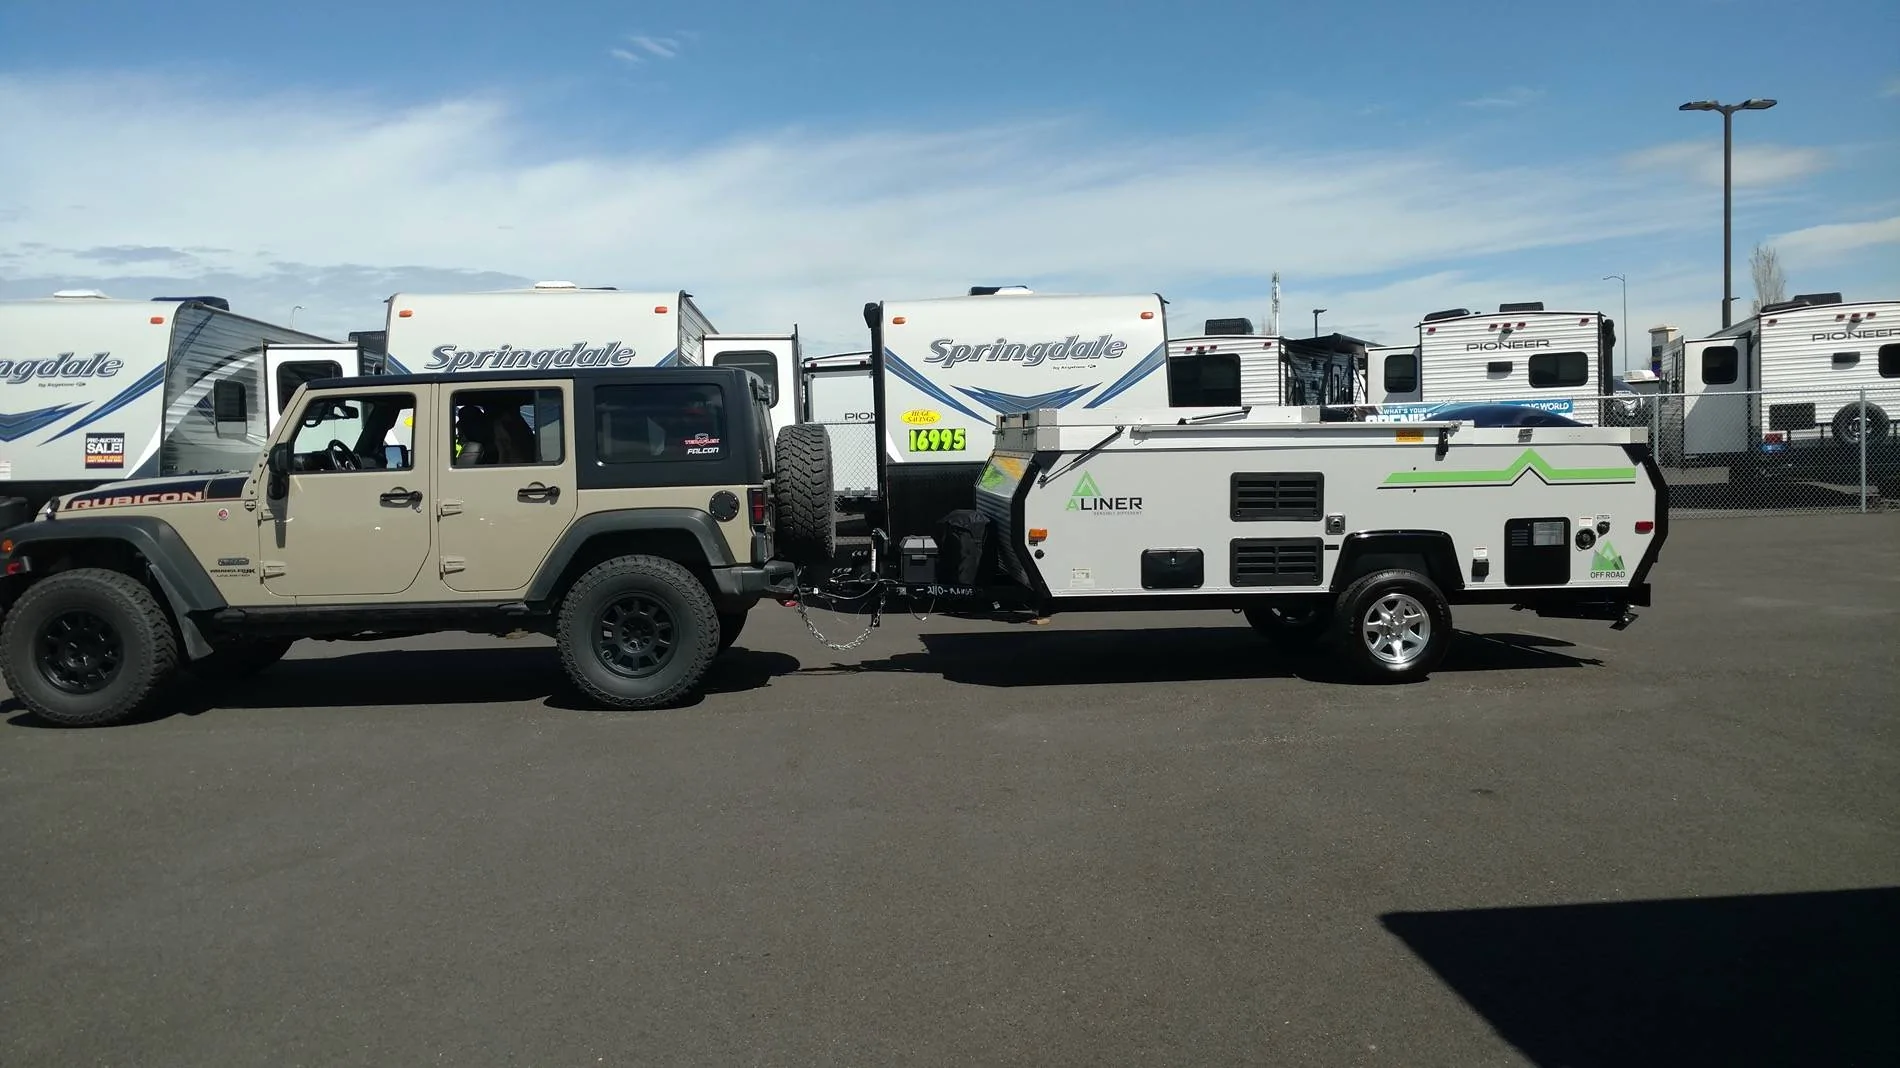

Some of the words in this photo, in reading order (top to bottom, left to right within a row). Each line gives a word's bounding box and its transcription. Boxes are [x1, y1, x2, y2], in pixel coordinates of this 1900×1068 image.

[923, 333, 1128, 369] Springdale
[1466, 339, 1550, 351] PIONEER
[424, 340, 636, 373] Springdale
[1539, 402, 1569, 411] WORLD
[87, 443, 122, 454] SALE!
[909, 429, 965, 451] 16995
[71, 491, 203, 509] RUBICON
